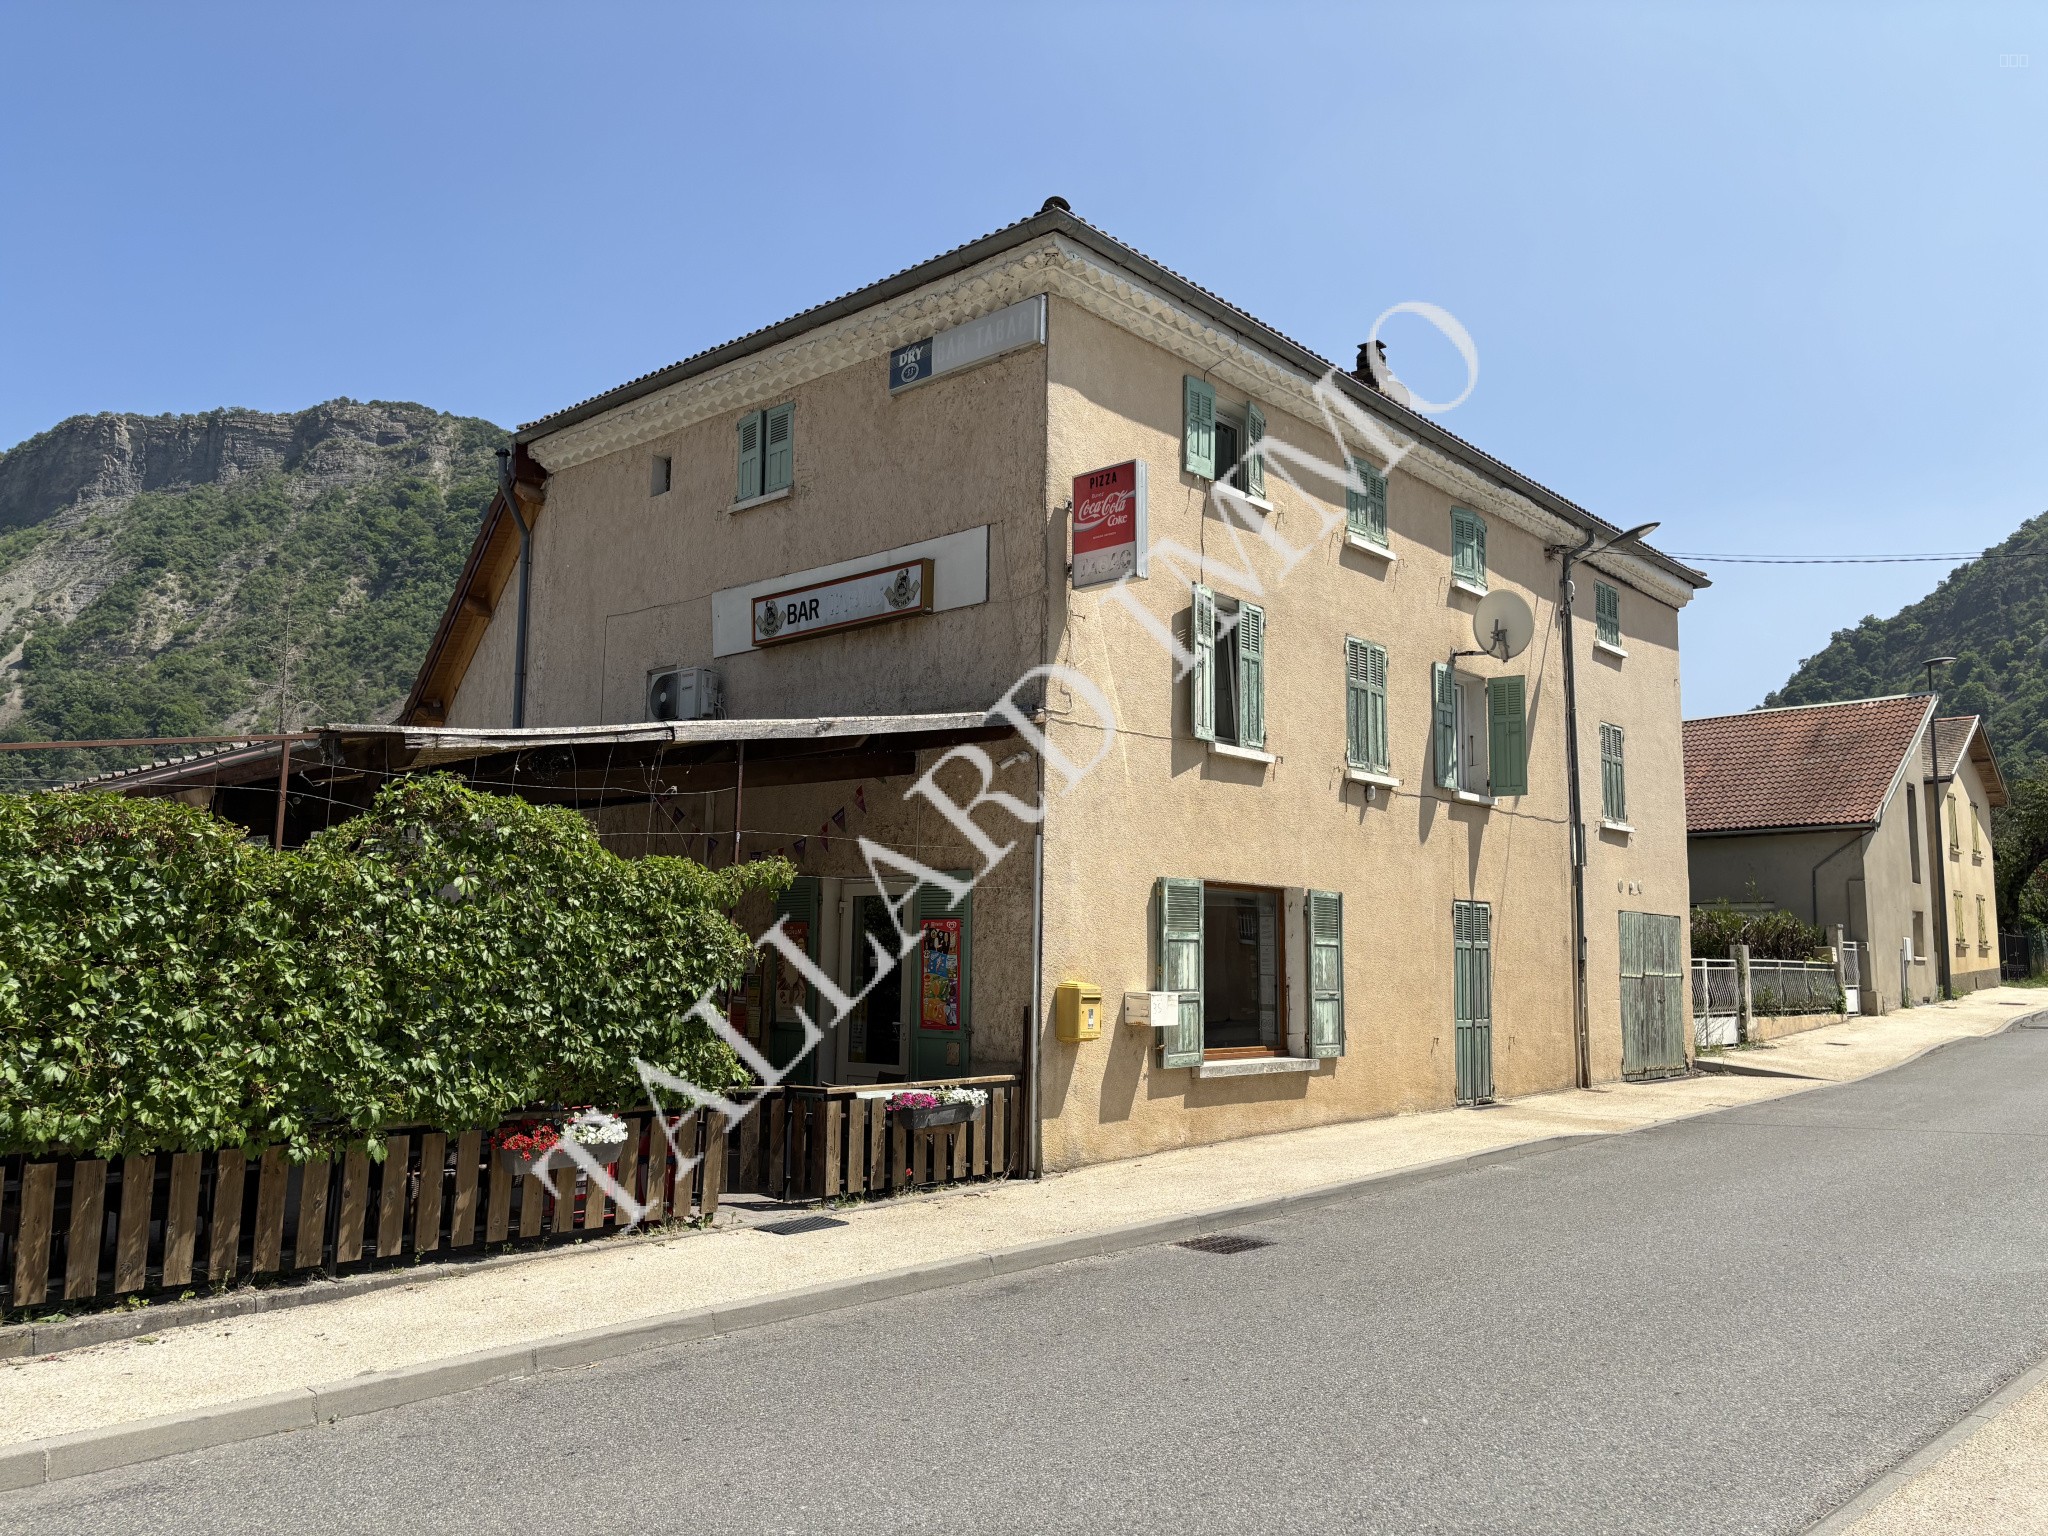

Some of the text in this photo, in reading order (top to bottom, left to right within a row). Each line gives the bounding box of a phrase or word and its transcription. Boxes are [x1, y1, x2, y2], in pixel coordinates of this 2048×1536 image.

[899, 346, 924, 368] DRY
[1089, 471, 1117, 489] PIZZA
[1107, 514, 1128, 527] Coke
[787, 598, 819, 625] BAR
